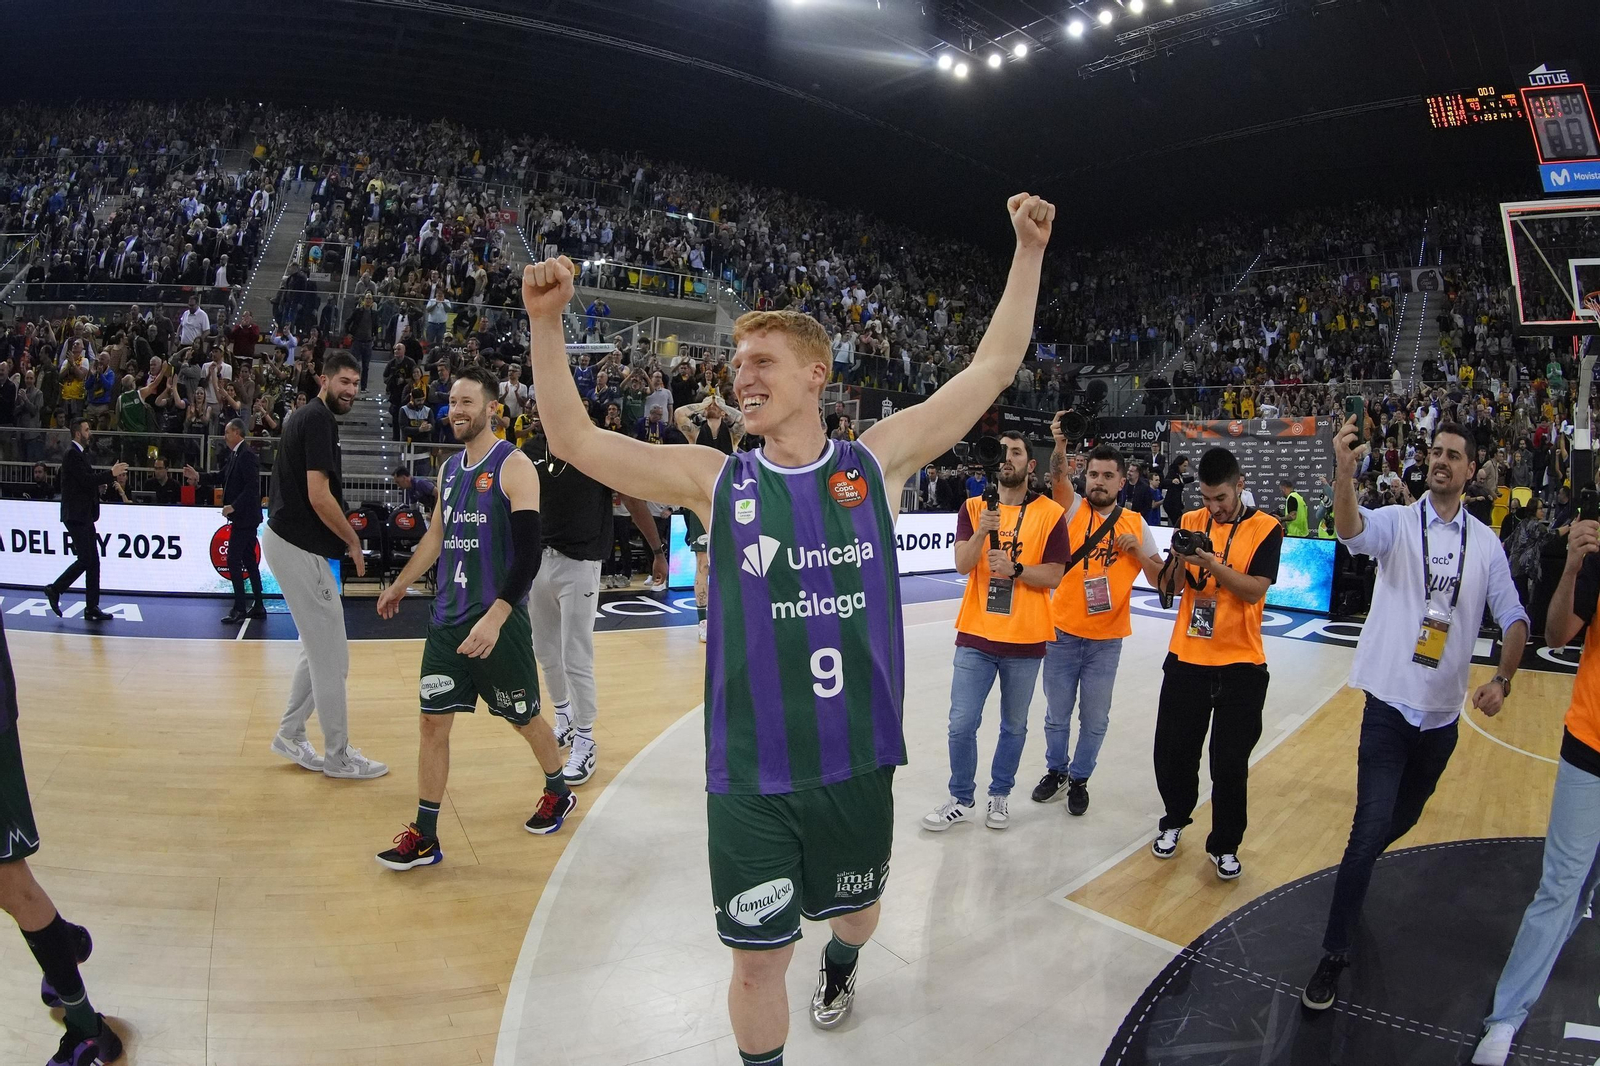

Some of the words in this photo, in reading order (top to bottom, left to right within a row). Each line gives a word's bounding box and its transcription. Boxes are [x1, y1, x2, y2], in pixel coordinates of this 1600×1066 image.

[1528, 73, 1570, 86] LOTUS
[1470, 102, 1480, 110] 93
[1141, 429, 1160, 441] Rey
[452, 510, 487, 526] Unicaja
[11, 529, 56, 554] DEL
[63, 532, 112, 557] RY
[118, 534, 182, 560] 2025
[444, 535, 479, 552] málaga
[787, 538, 874, 570] Unicaja
[1432, 554, 1450, 565] acb
[454, 561, 468, 588] 4
[772, 590, 866, 619] málaga
[810, 647, 844, 698] 9
[421, 677, 452, 689] amadesa
[734, 882, 792, 918] famadesa
